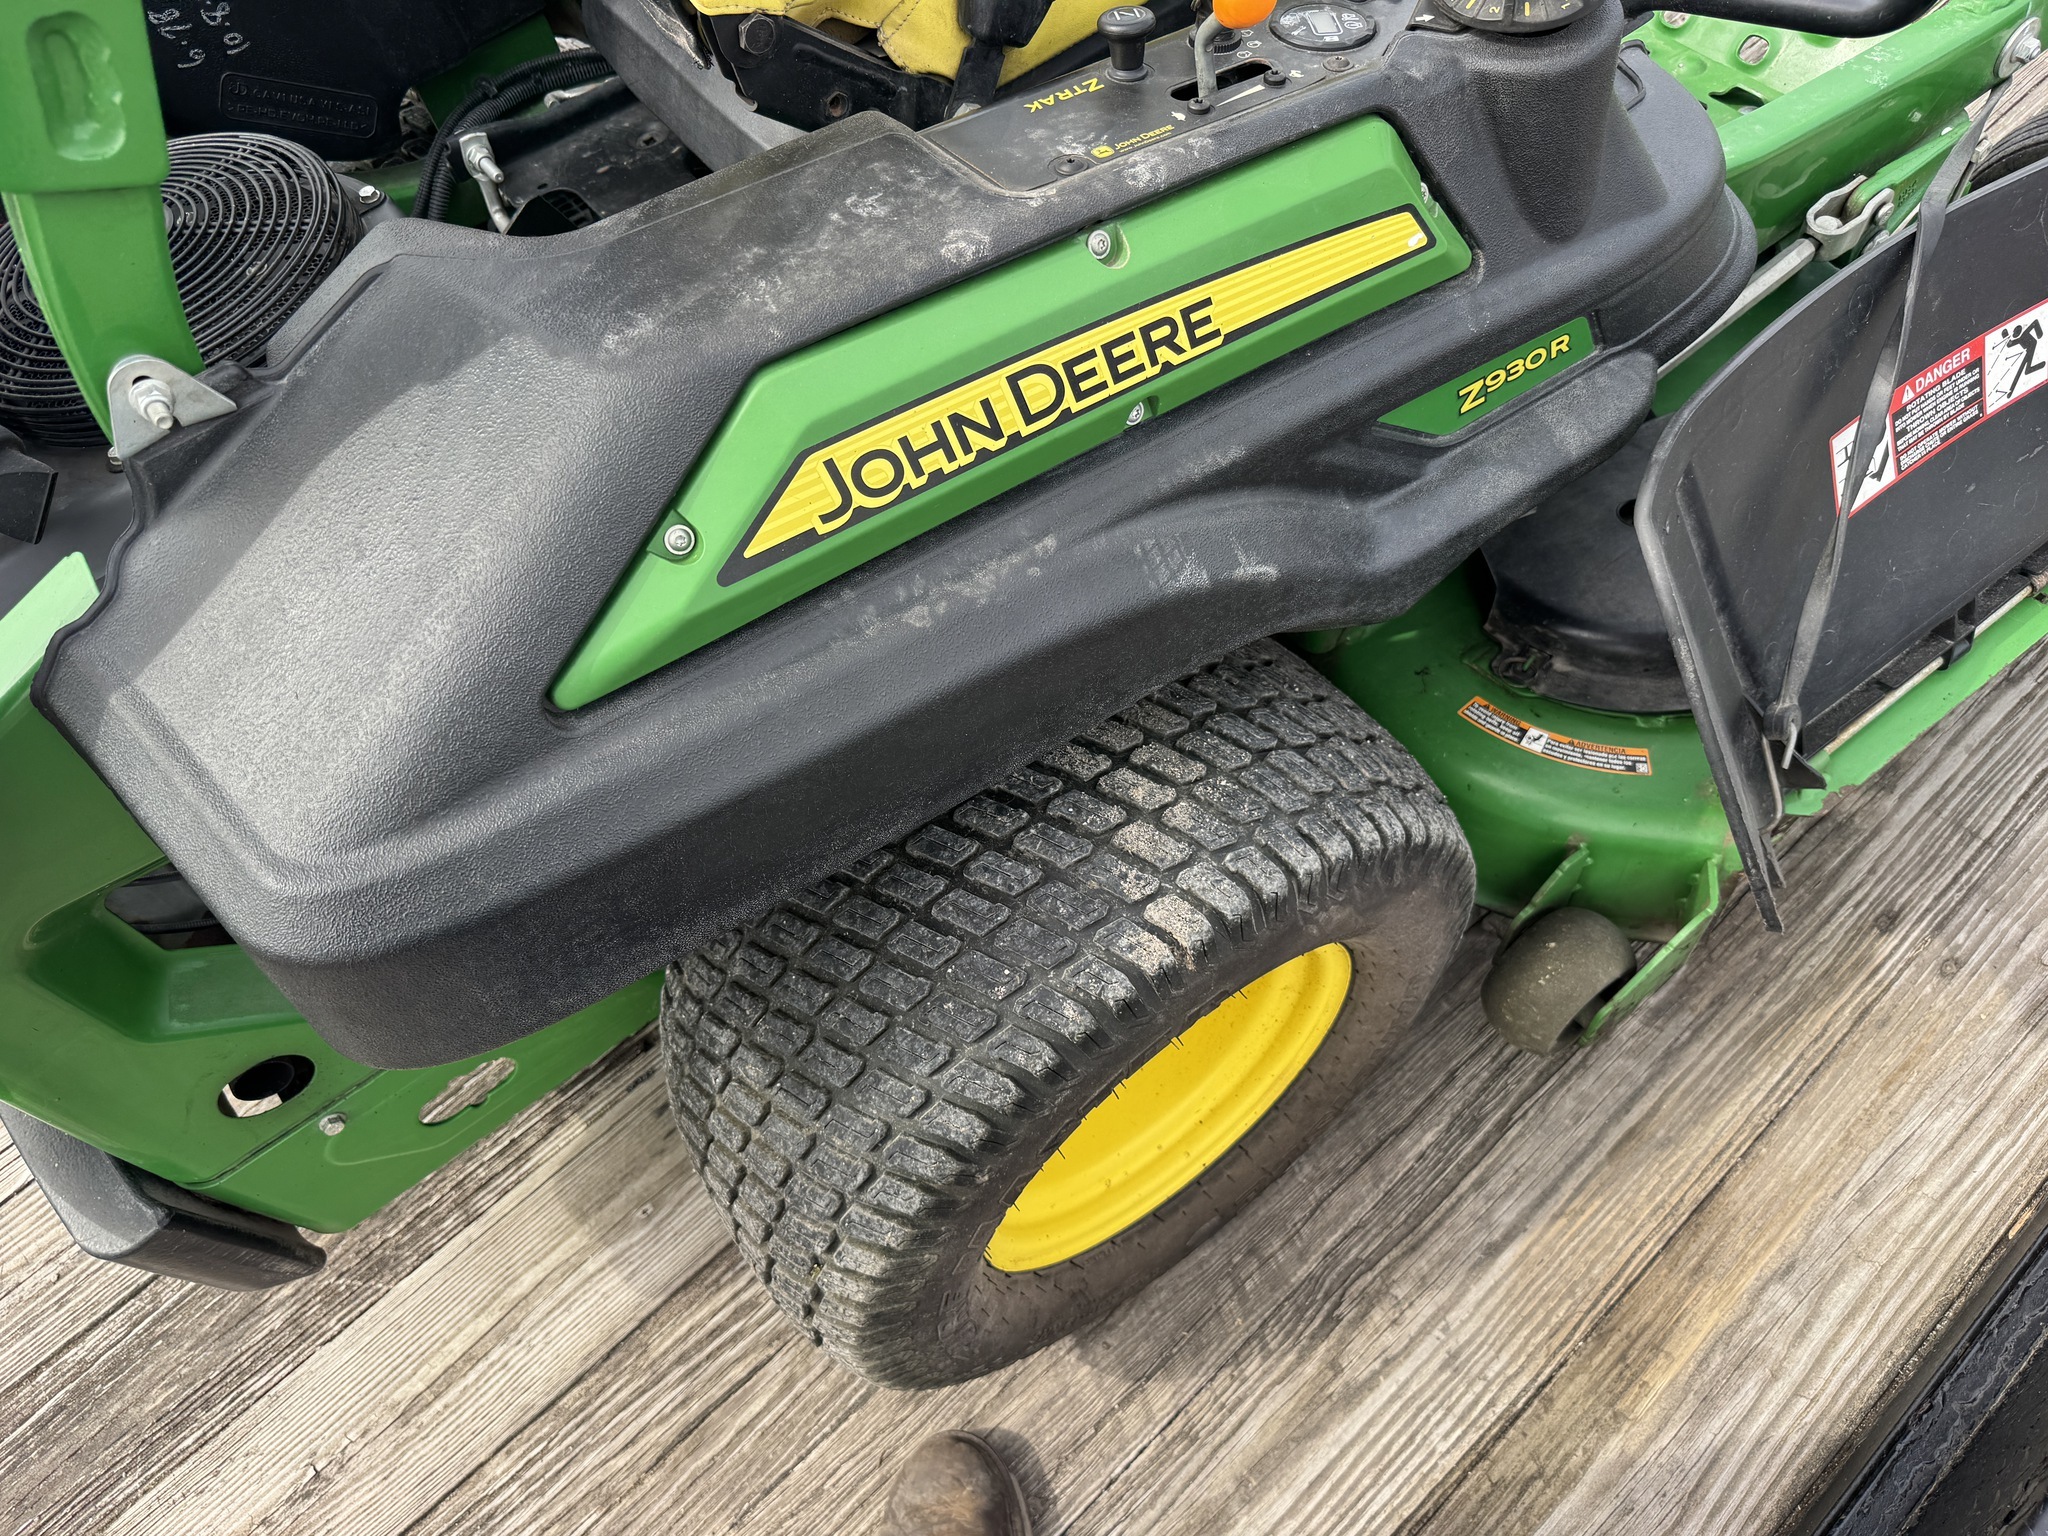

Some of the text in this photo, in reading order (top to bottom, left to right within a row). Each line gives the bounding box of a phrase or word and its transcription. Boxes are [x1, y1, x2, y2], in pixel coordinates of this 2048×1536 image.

[1023, 77, 1105, 113] ZTRAK
[1114, 124, 1175, 150] JOHN DEERE
[1458, 333, 1571, 415] Z930R
[1906, 368, 1965, 411] ROTATING BLADE
[1915, 347, 1970, 393] DANGER
[817, 296, 1223, 525] JOHN DEERE
[1906, 386, 1968, 432] THROWN OBJECTS
[1492, 707, 1522, 726] WARNING
[1576, 740, 1626, 754] ADVERTENCIA
